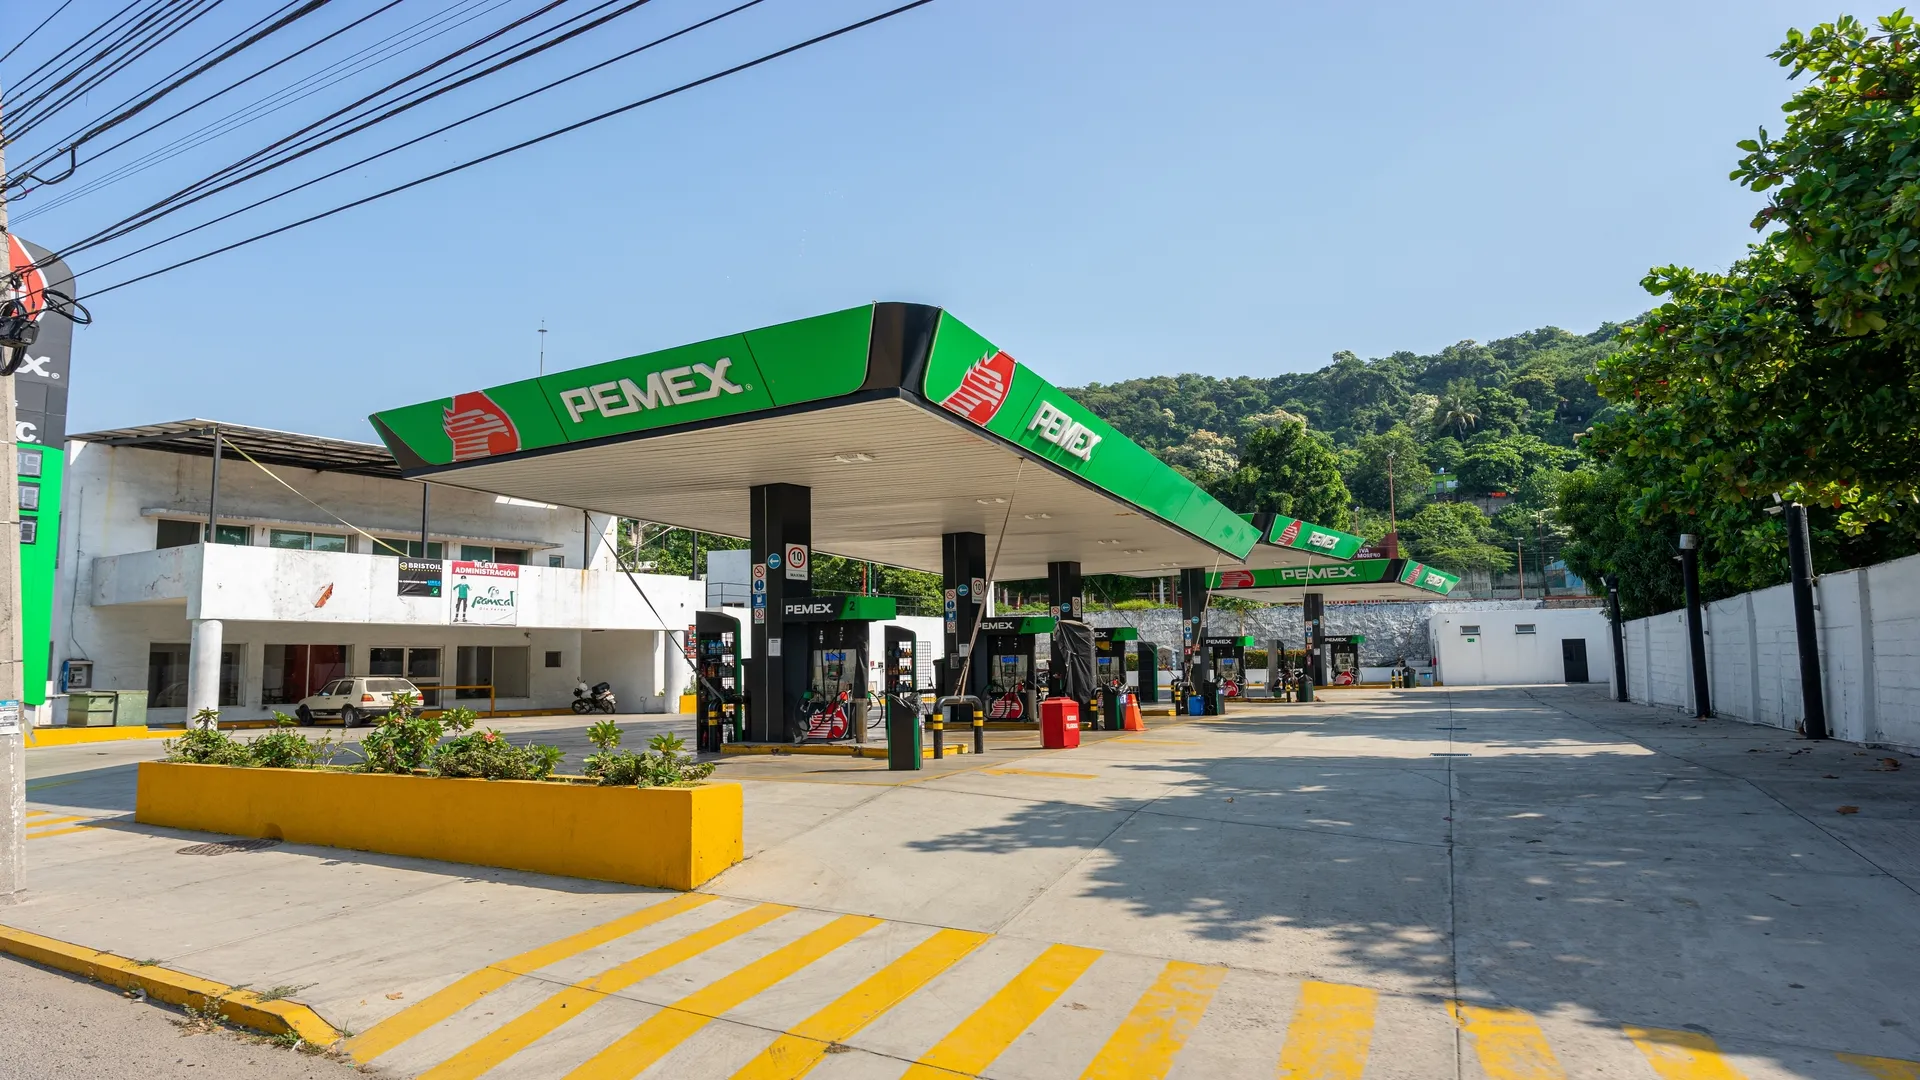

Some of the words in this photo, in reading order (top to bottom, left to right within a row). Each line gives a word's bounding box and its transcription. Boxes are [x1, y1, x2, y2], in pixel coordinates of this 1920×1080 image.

[560, 357, 743, 423] PEMEX
[1027, 400, 1103, 462] PEMEX
[1307, 531, 1340, 550] PEMEX
[791, 551, 802, 561] 10
[408, 562, 442, 570] BRISTOIL
[474, 561, 498, 569] NUEVA
[455, 567, 517, 577] ADMINISTRACIÓN
[1281, 566, 1357, 580] PEMEX
[785, 603, 832, 615] PEMEX
[849, 601, 855, 611] 2
